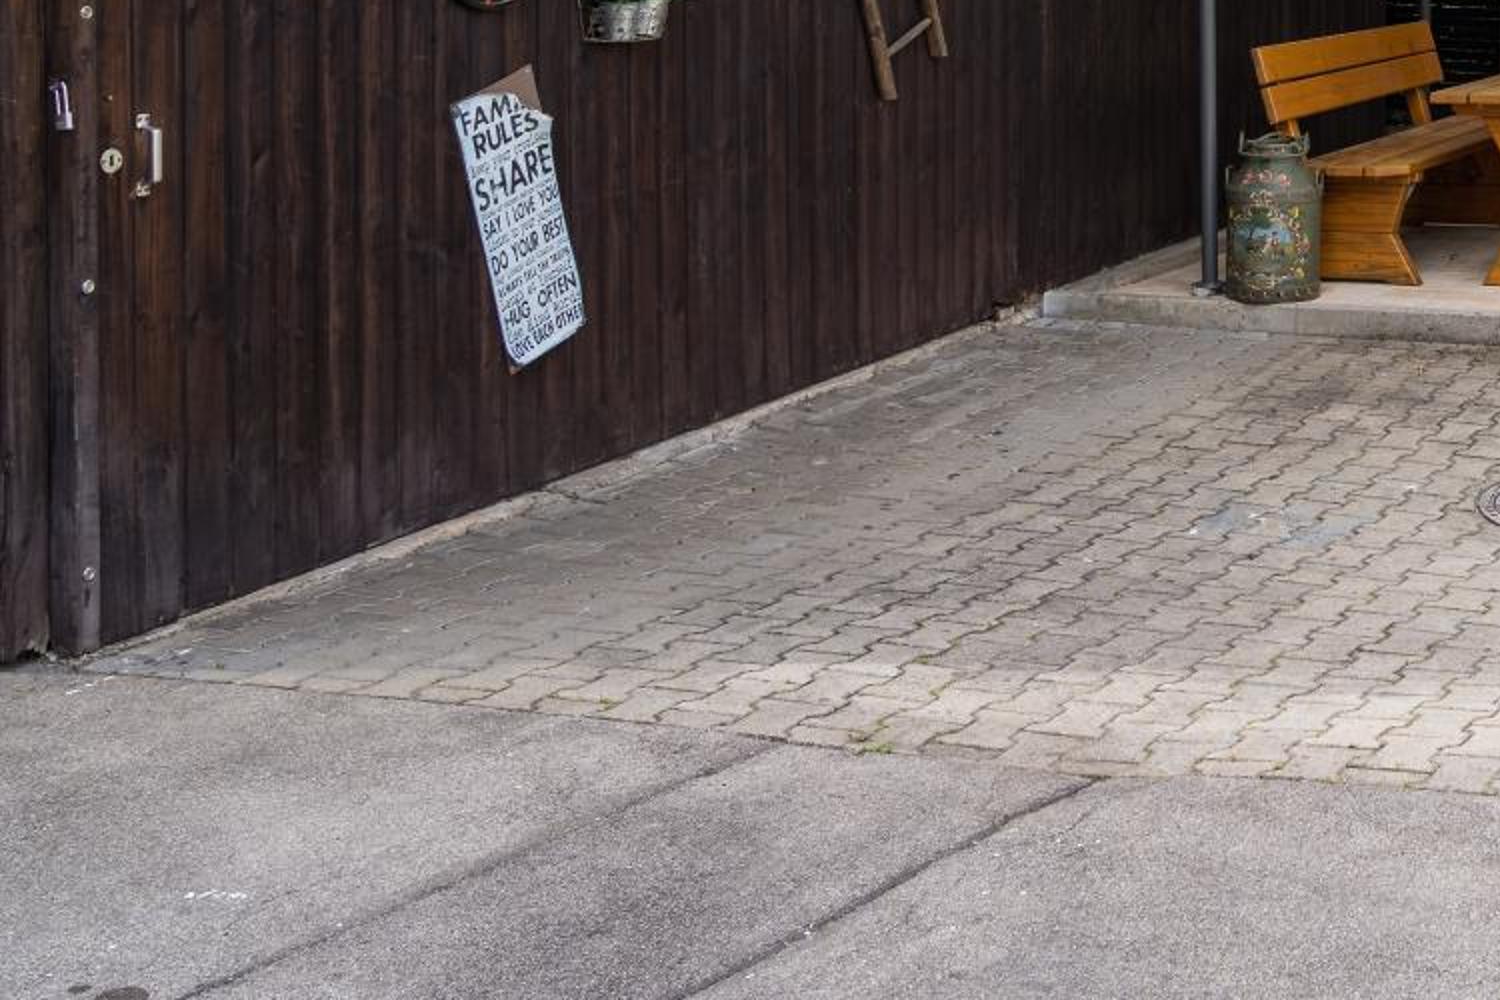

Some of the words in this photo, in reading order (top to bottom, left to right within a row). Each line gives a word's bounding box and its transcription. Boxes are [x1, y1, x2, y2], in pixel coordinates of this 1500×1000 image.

[472, 111, 539, 159] RULES
[475, 143, 552, 212] SHARE
[483, 215, 502, 241] SAY
[512, 195, 536, 223] LOVE
[538, 183, 560, 207] YOU
[491, 249, 509, 276] DO
[511, 230, 539, 263] YOUR
[542, 215, 565, 243] BEST
[504, 300, 531, 329] HUG
[537, 271, 577, 308] OFTEN
[510, 335, 535, 360] LOVE
[533, 319, 555, 345] EACH
